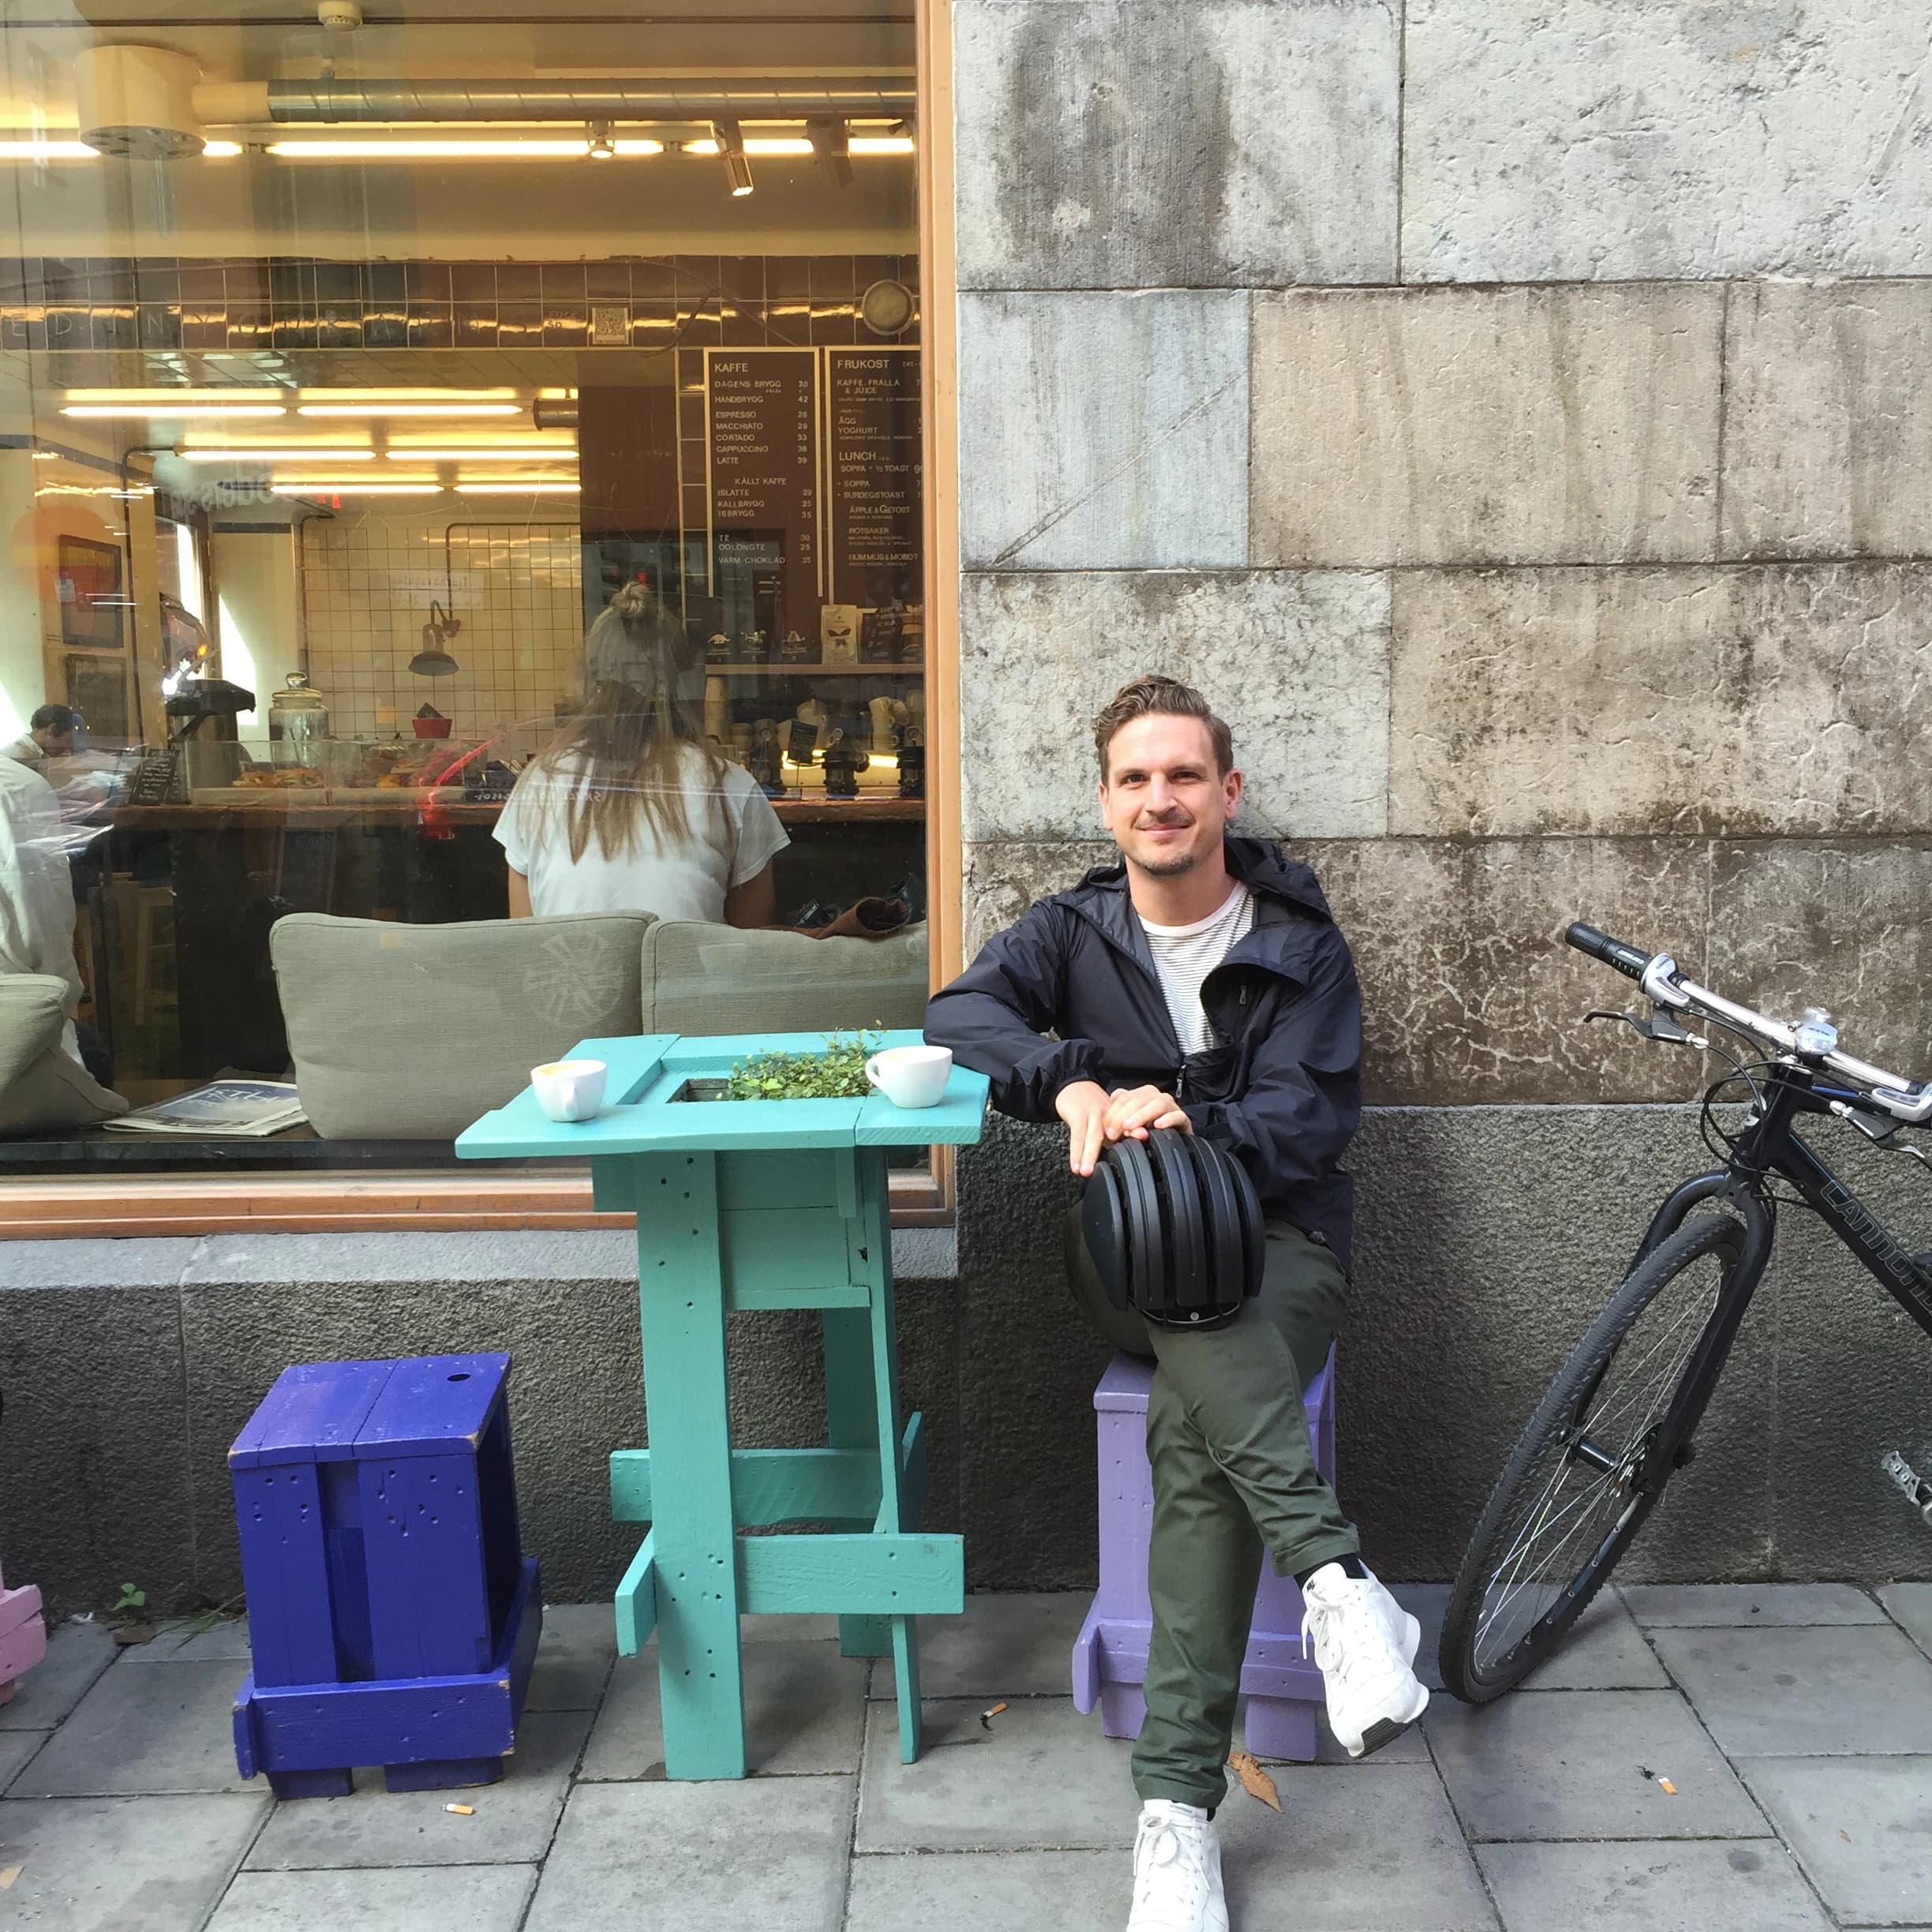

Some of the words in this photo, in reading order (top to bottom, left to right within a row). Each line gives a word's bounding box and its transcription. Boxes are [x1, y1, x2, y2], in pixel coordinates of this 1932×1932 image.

[714, 363, 748, 373] KAFFE
[837, 360, 889, 369] FRUKOST
[839, 451, 877, 461] LUNCH
[843, 491, 905, 500] SURDEGSTOAST
